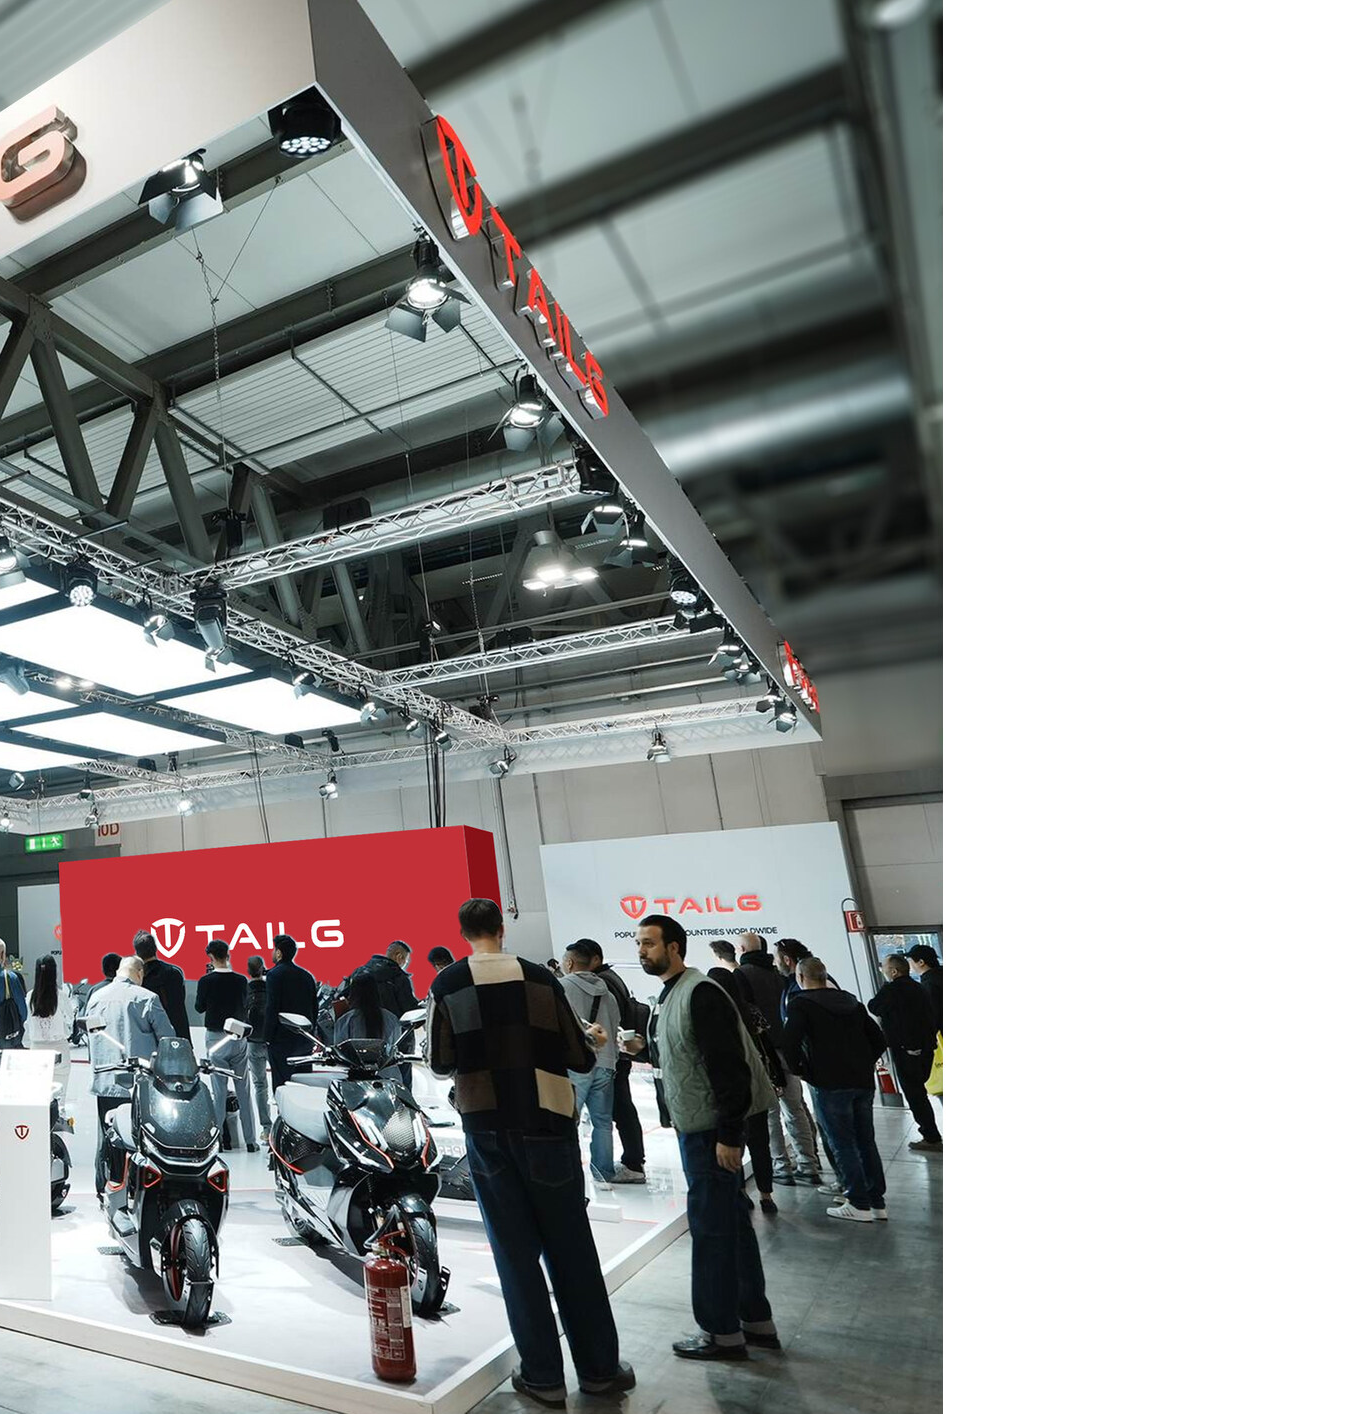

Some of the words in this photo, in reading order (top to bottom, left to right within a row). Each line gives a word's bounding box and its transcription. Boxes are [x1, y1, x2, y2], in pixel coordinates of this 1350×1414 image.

[489, 205, 609, 417] TAILG
[653, 894, 763, 914] TAILG
[614, 931, 637, 939] POPU
[683, 928, 725, 938] OUNTRIES
